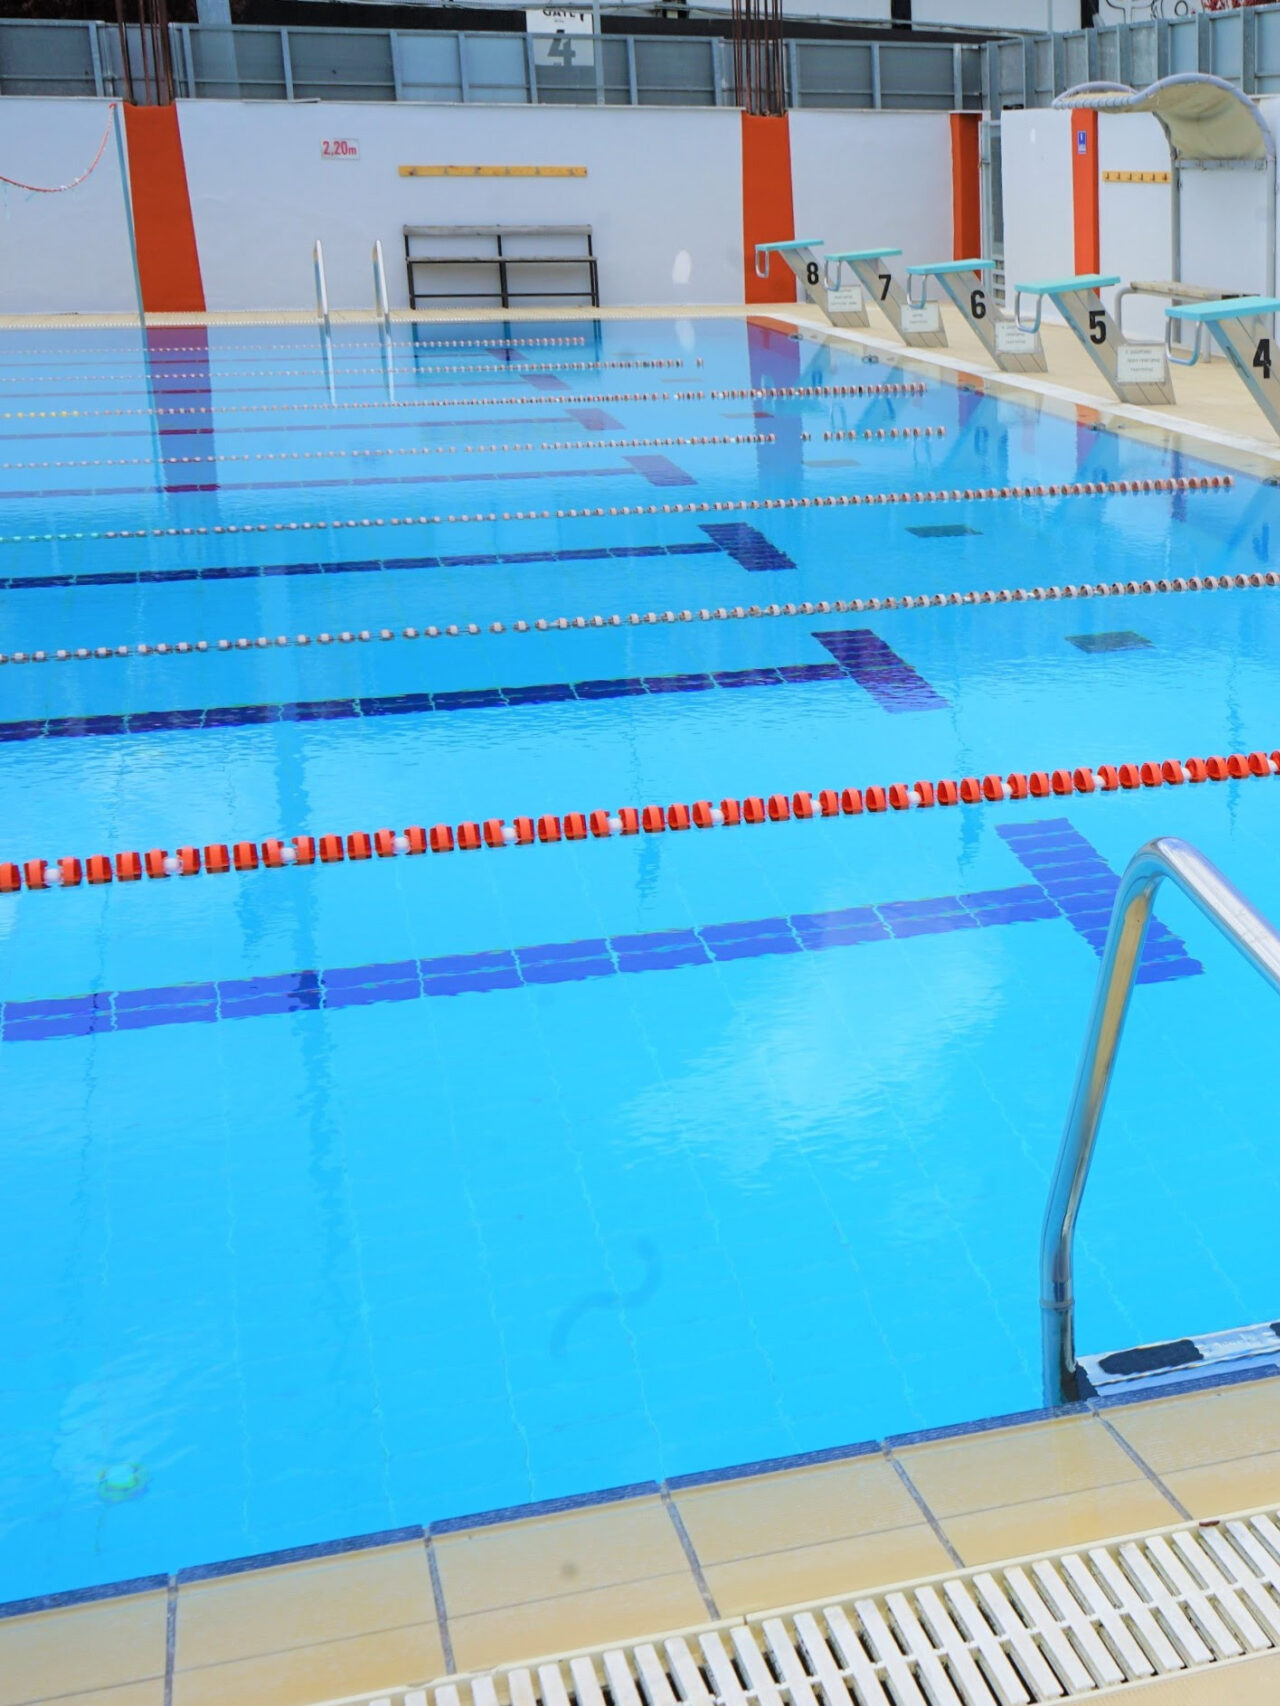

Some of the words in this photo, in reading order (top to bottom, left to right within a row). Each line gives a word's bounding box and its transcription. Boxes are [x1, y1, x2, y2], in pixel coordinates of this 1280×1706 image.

[547, 29, 576, 67] 4
[806, 261, 819, 285] 8
[878, 274, 892, 301] 7
[970, 290, 987, 319] 6
[1089, 310, 1107, 344] 5
[1253, 338, 1272, 379] 4
